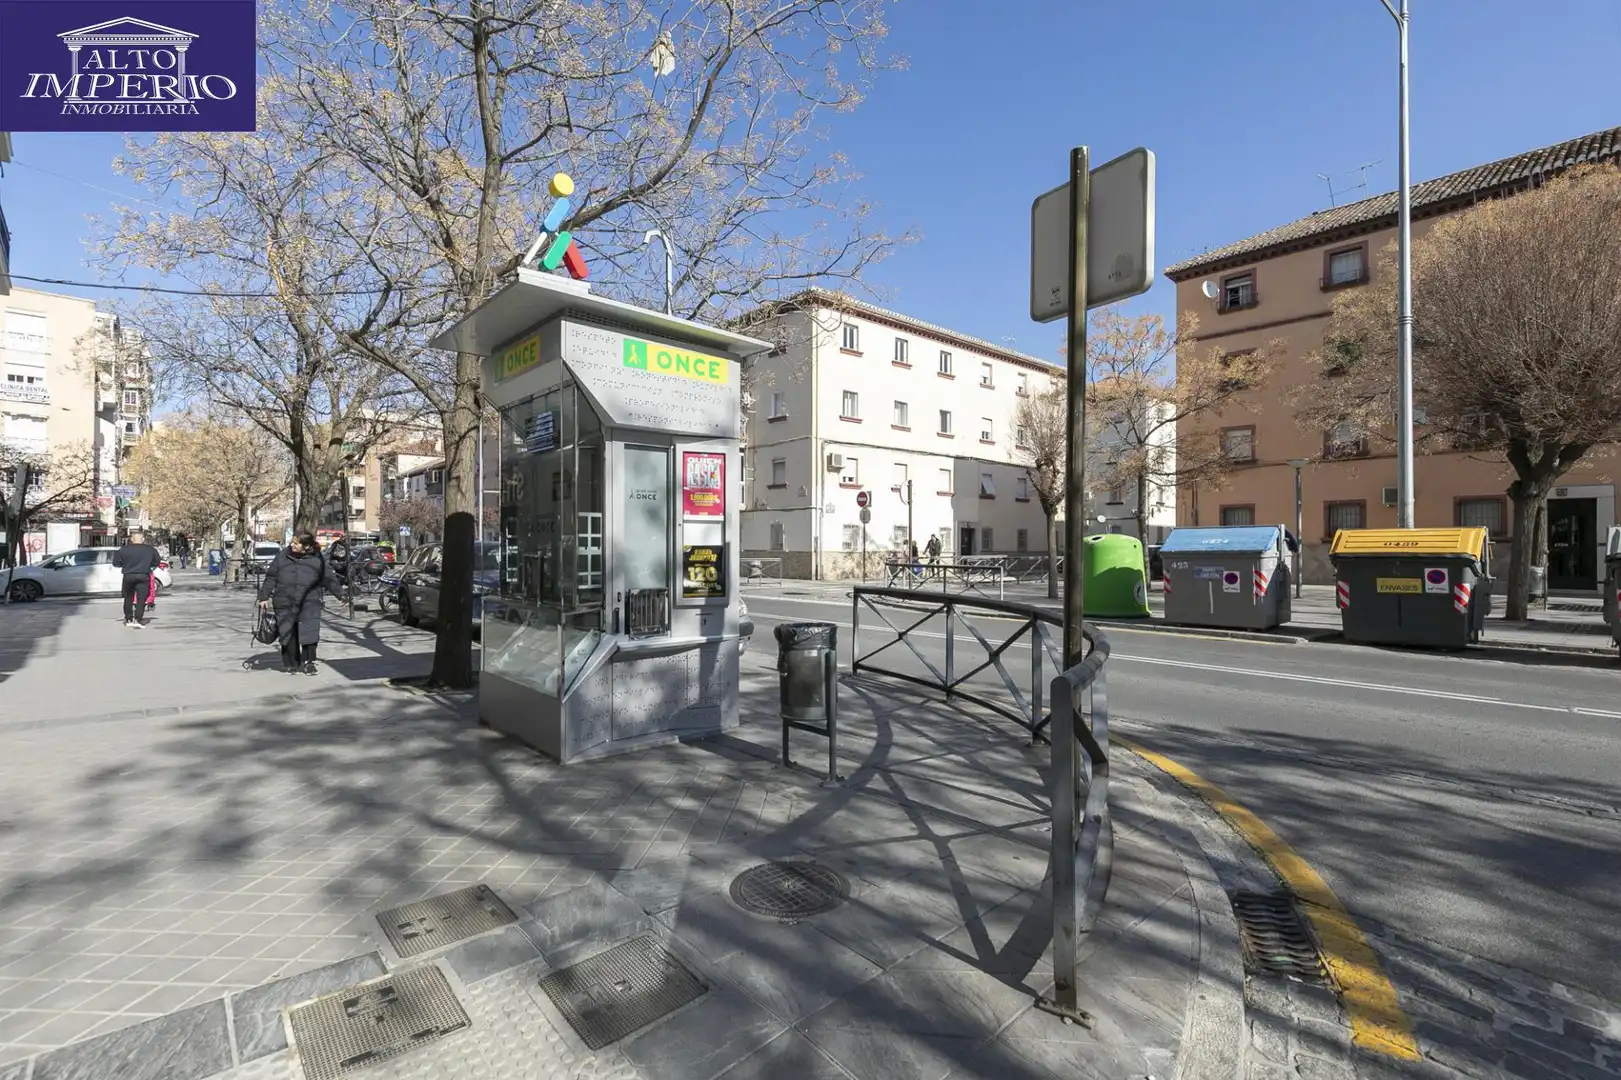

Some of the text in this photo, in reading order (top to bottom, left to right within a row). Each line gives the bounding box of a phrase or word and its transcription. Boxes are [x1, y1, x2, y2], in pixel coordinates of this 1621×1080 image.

[507, 341, 536, 372] ONCE
[657, 351, 720, 380] ONCE
[636, 493, 657, 501] ONCE
[687, 566, 718, 582] 120
[1380, 584, 1419, 592] ENVASES
